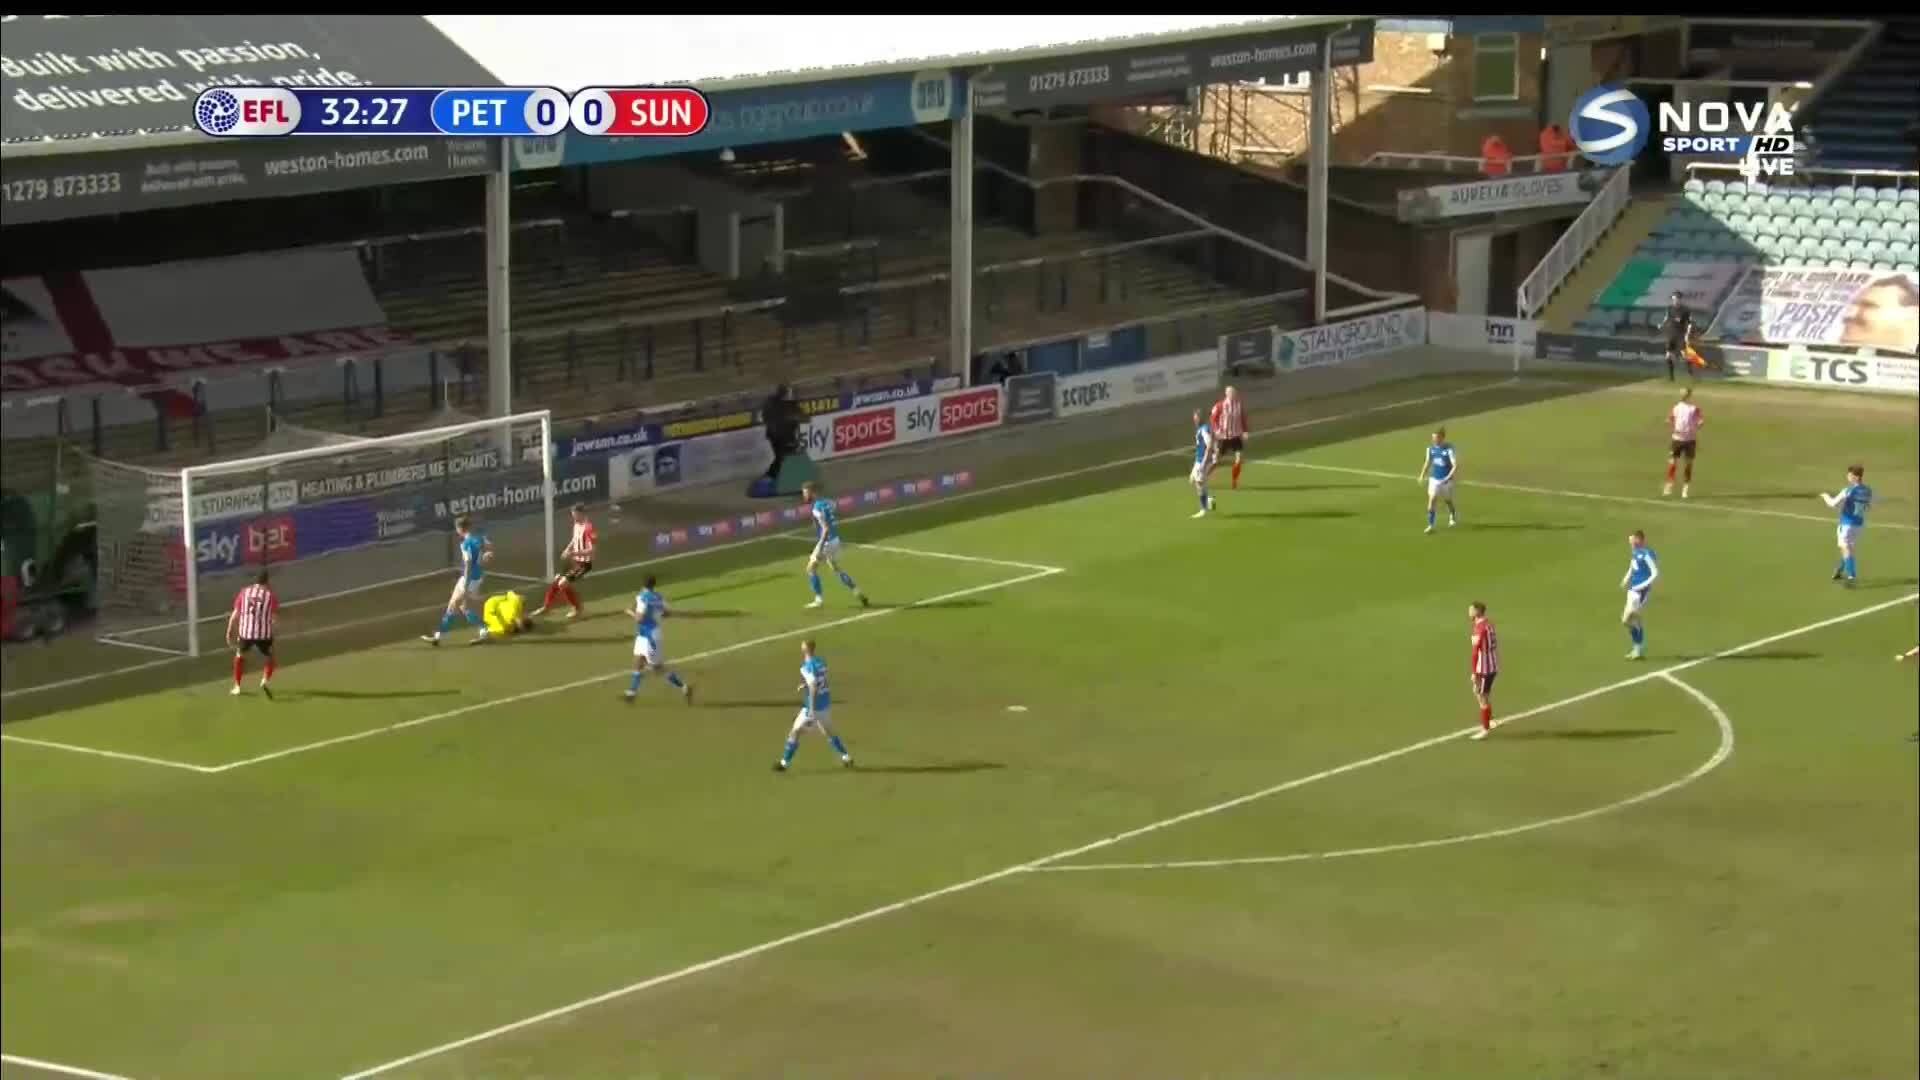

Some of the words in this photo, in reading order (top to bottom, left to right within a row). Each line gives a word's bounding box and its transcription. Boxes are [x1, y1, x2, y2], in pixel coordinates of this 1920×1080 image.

[1, 51, 91, 78] Built
[90, 47, 178, 72] with
[177, 39, 322, 72] passion,
[14, 79, 188, 112] delivered
[264, 144, 430, 176] weston-homes.com
[54, 171, 122, 196] 873333
[1451, 186, 1510, 203] AURELIA
[1776, 302, 1843, 324] POSH
[1299, 313, 1401, 352] STANGROUND
[1791, 358, 1869, 384] ETCS
[907, 408, 937, 433] sky
[943, 396, 997, 425] sports
[800, 425, 830, 451] sky
[836, 415, 893, 446] sports
[302, 477, 352, 497] HEATING
[429, 453, 498, 480] MECHANTS
[434, 473, 597, 518] weston-homs.com
[197, 531, 240, 564] sky
[249, 523, 290, 552] bet
